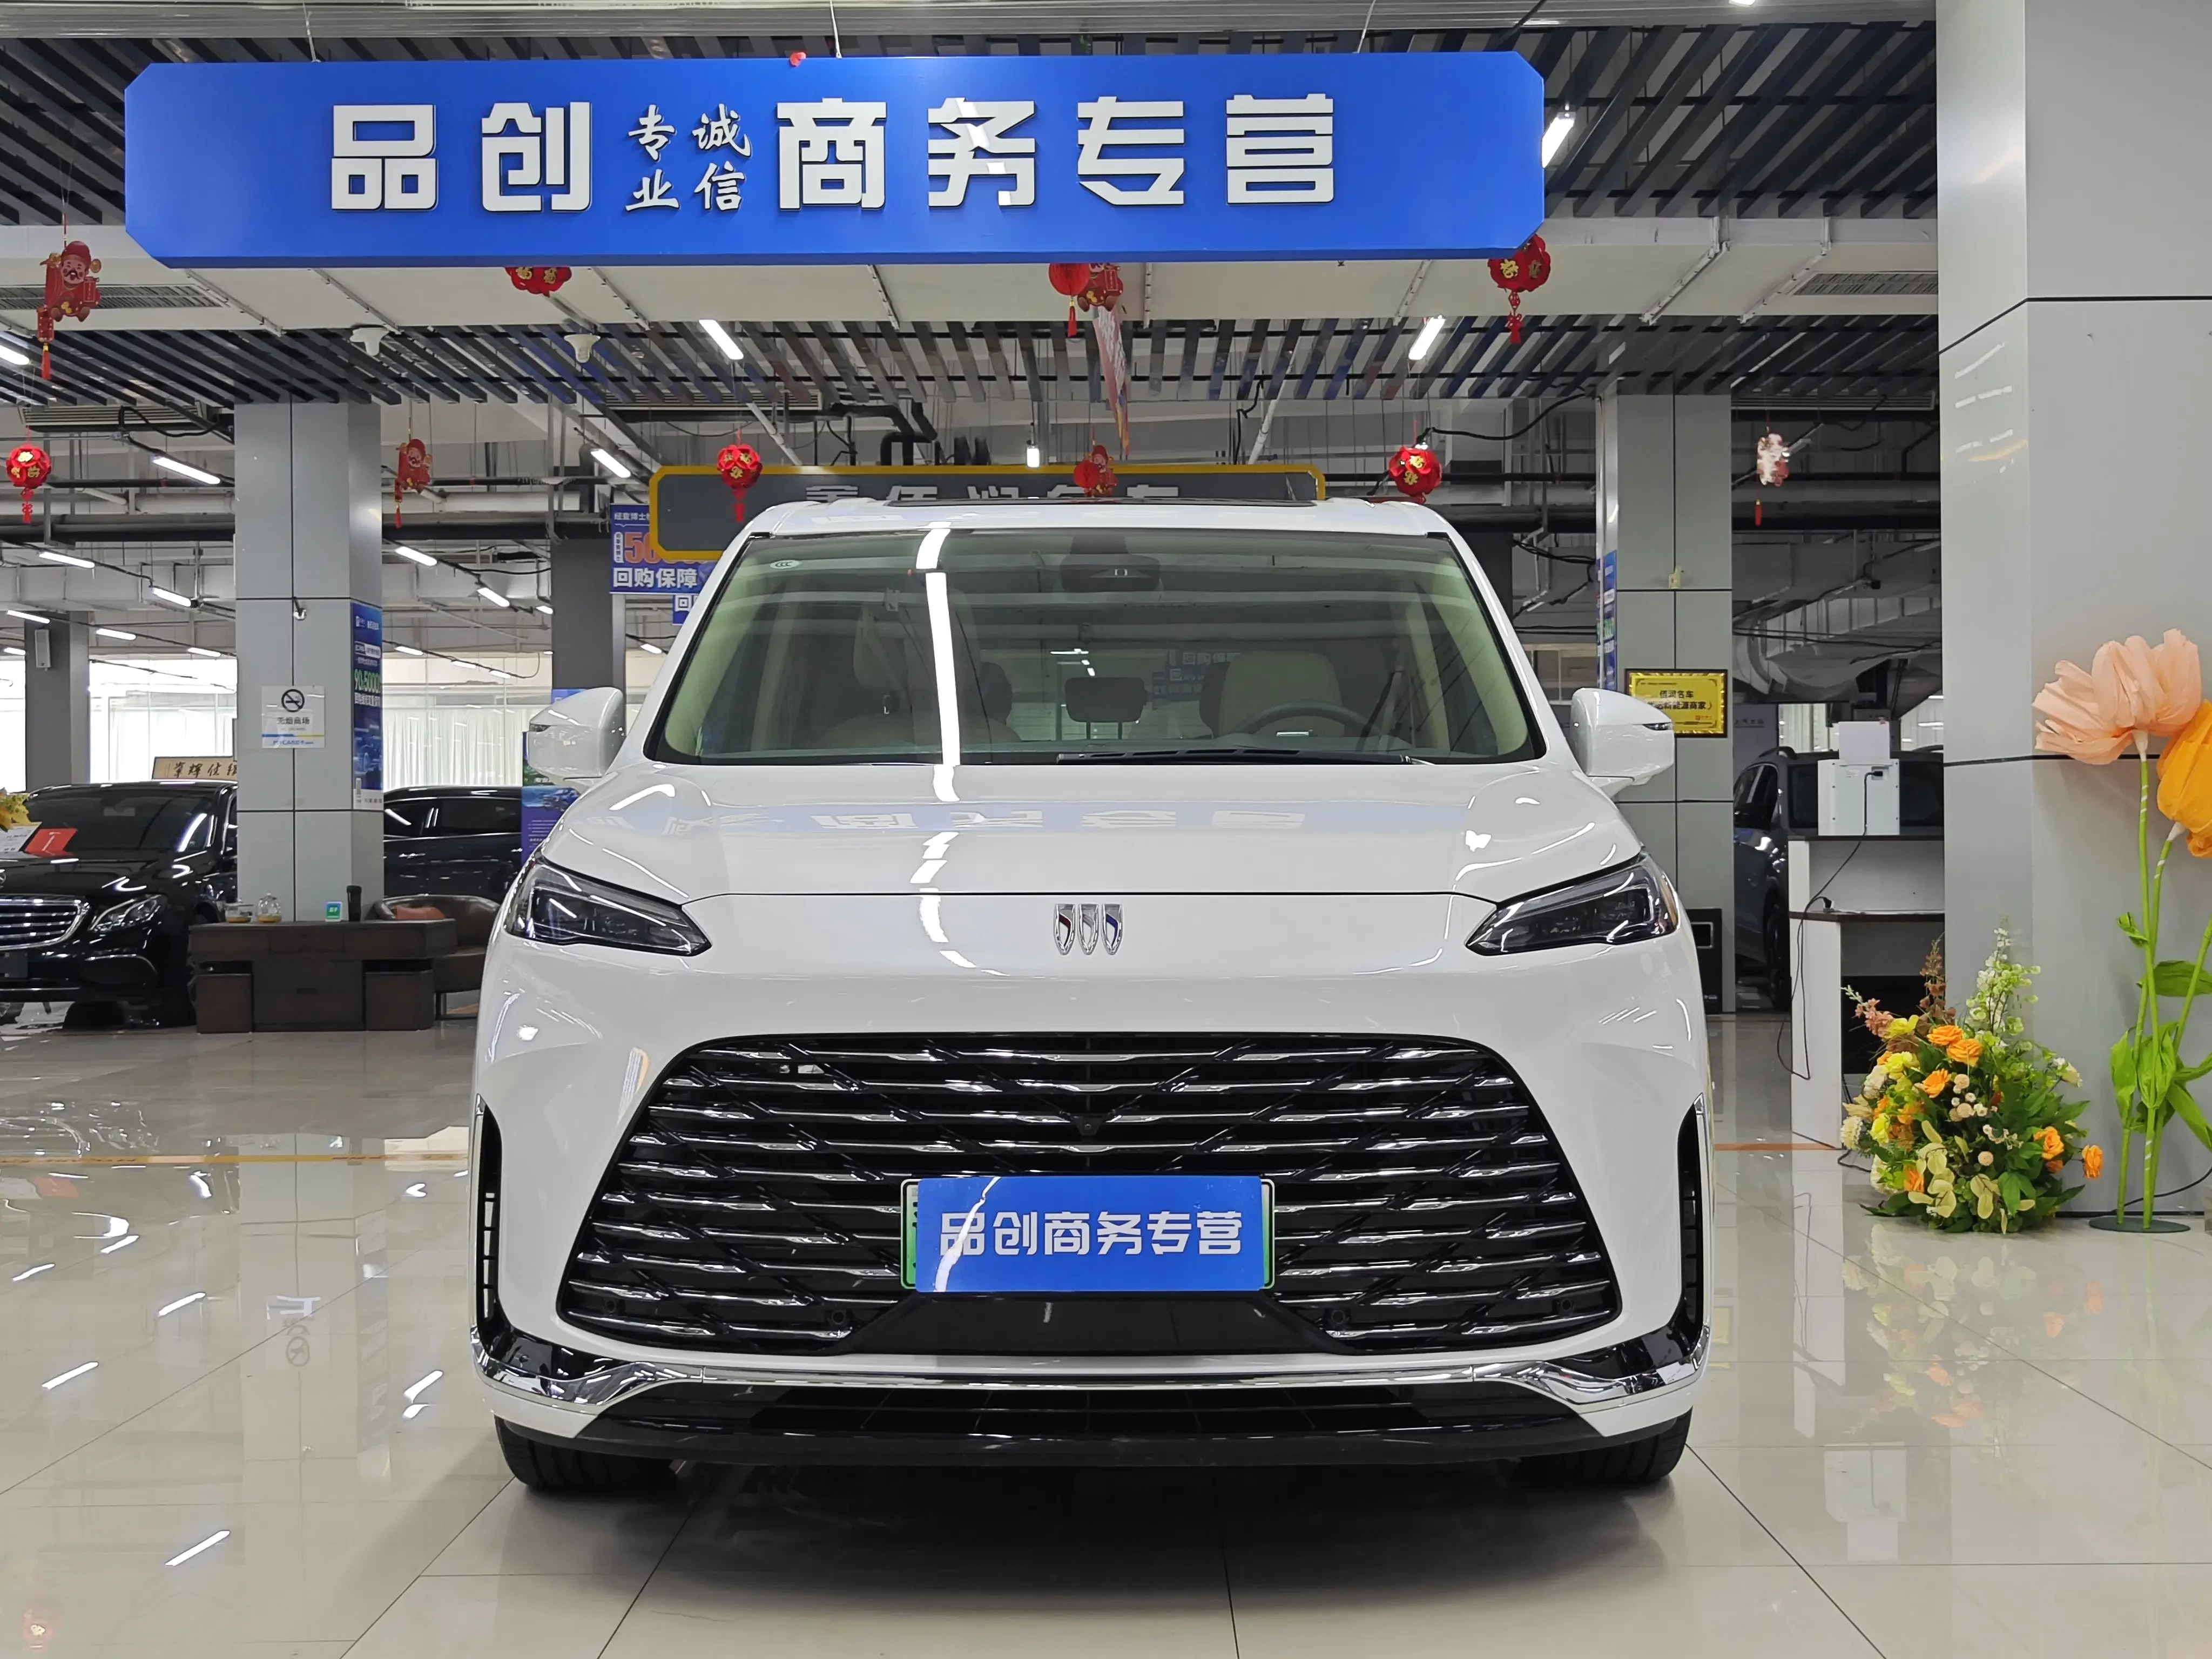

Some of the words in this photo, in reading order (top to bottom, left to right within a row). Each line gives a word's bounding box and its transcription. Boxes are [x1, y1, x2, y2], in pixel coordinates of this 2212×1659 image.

[331, 102, 591, 212] 品创
[777, 93, 1334, 210] 商务专营
[613, 568, 698, 588] 回购保障
[276, 717, 310, 725] 无烟商场
[940, 1210, 1243, 1256] 品创商务专营
